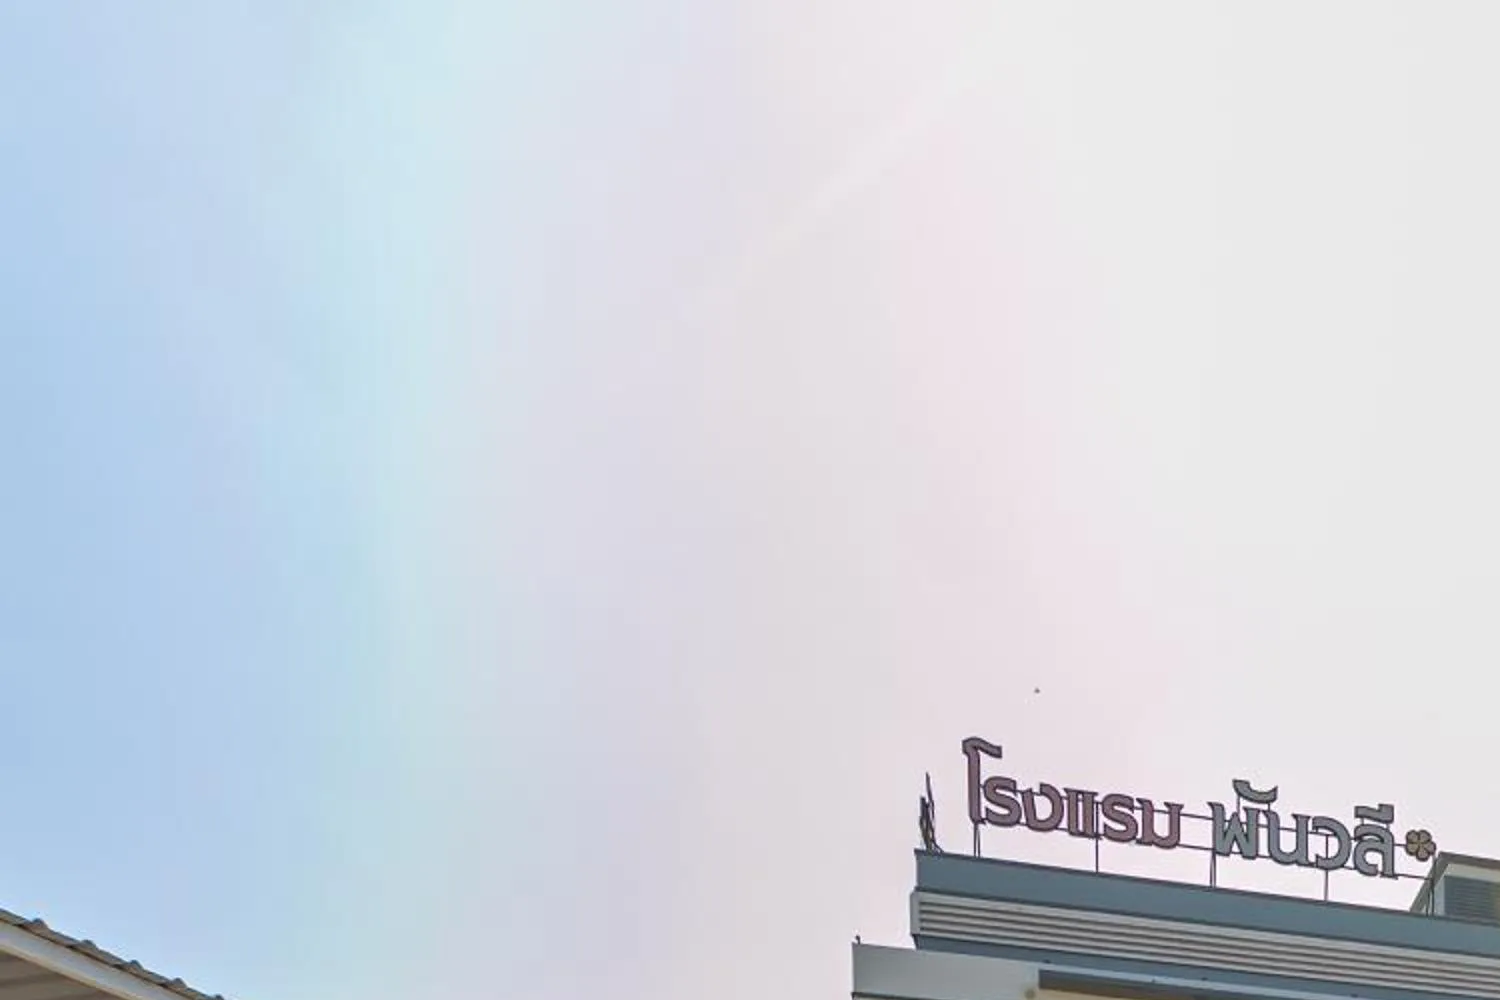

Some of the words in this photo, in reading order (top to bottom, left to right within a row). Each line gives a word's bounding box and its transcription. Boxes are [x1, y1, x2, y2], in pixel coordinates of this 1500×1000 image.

[961, 736, 1184, 849] โรงแรม
[1207, 779, 1398, 879] พันวลี
